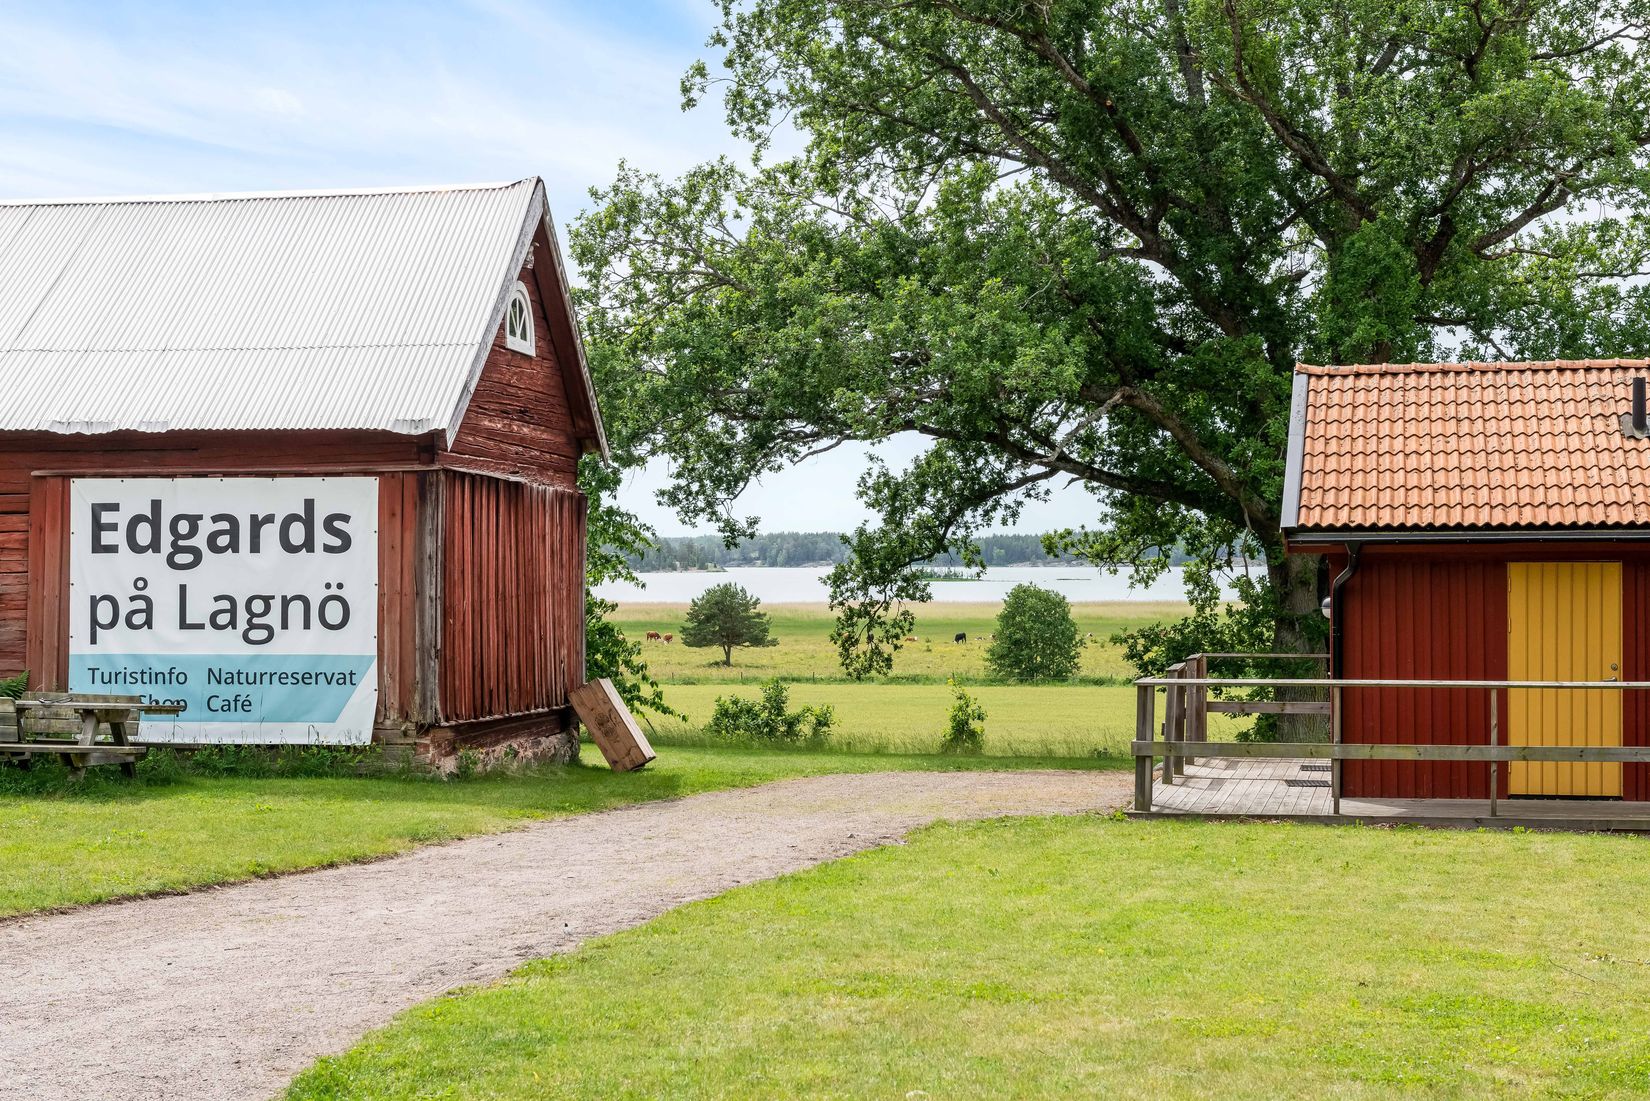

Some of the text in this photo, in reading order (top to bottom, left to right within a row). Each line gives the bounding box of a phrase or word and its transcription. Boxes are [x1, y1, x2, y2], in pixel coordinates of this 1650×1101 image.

[90, 498, 352, 570] Edgards
[89, 576, 351, 645] på Lagnö
[88, 667, 357, 686] Turistinfo Naturreservat
[206, 694, 253, 713] Café
